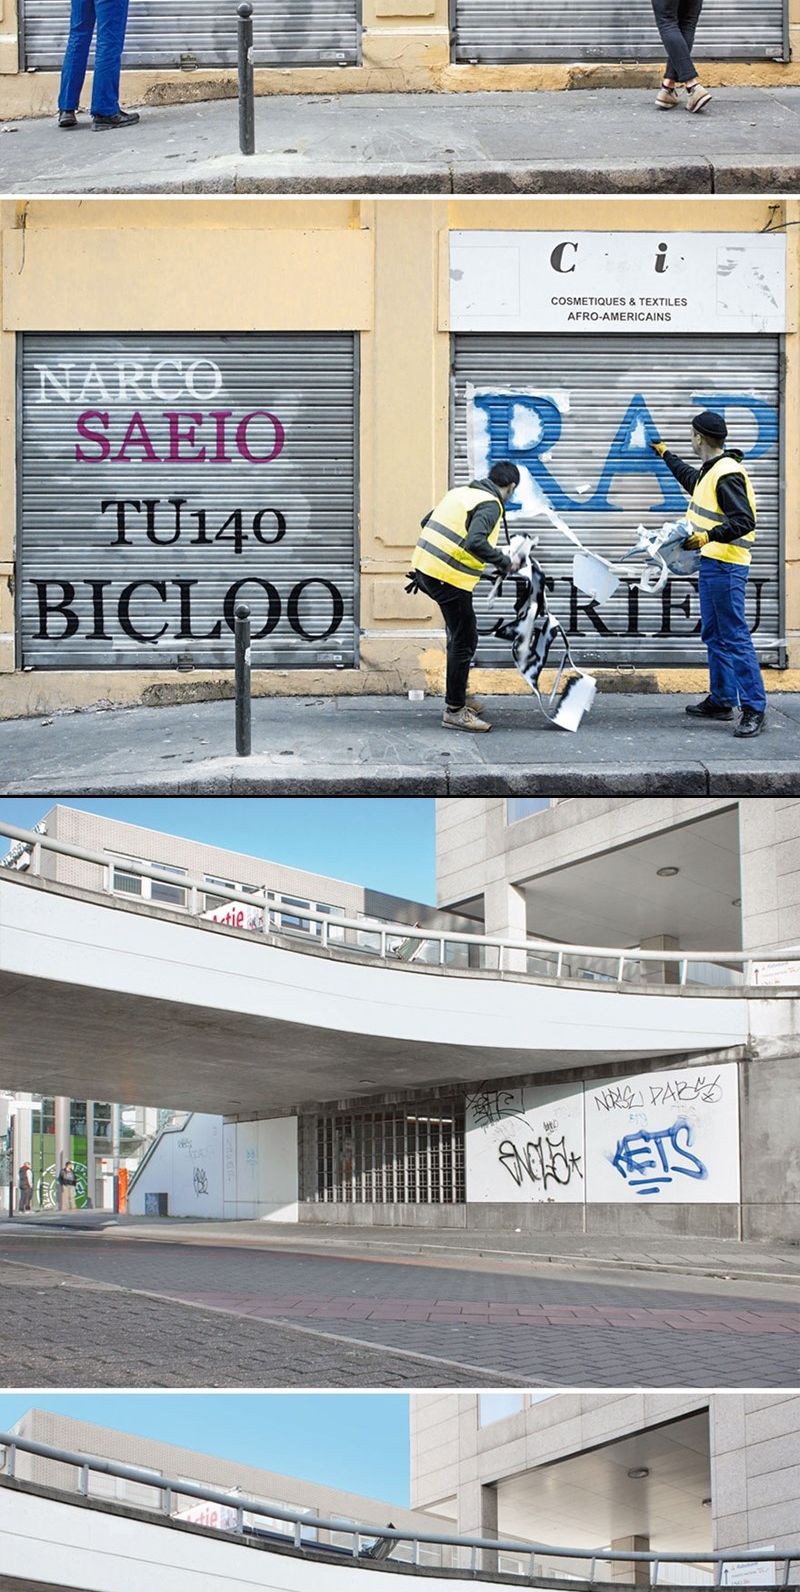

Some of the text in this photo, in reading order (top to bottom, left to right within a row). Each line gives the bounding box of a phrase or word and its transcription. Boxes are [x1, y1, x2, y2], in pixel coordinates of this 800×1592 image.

[551, 297, 688, 307] COSMETIQUES & TEXTILES
[567, 312, 672, 322] AFRO-AMERICAINS
[34, 358, 223, 403] NARCO
[74, 410, 285, 464] SAEIO
[101, 500, 287, 554] TU140
[30, 577, 345, 644] BICLOO
